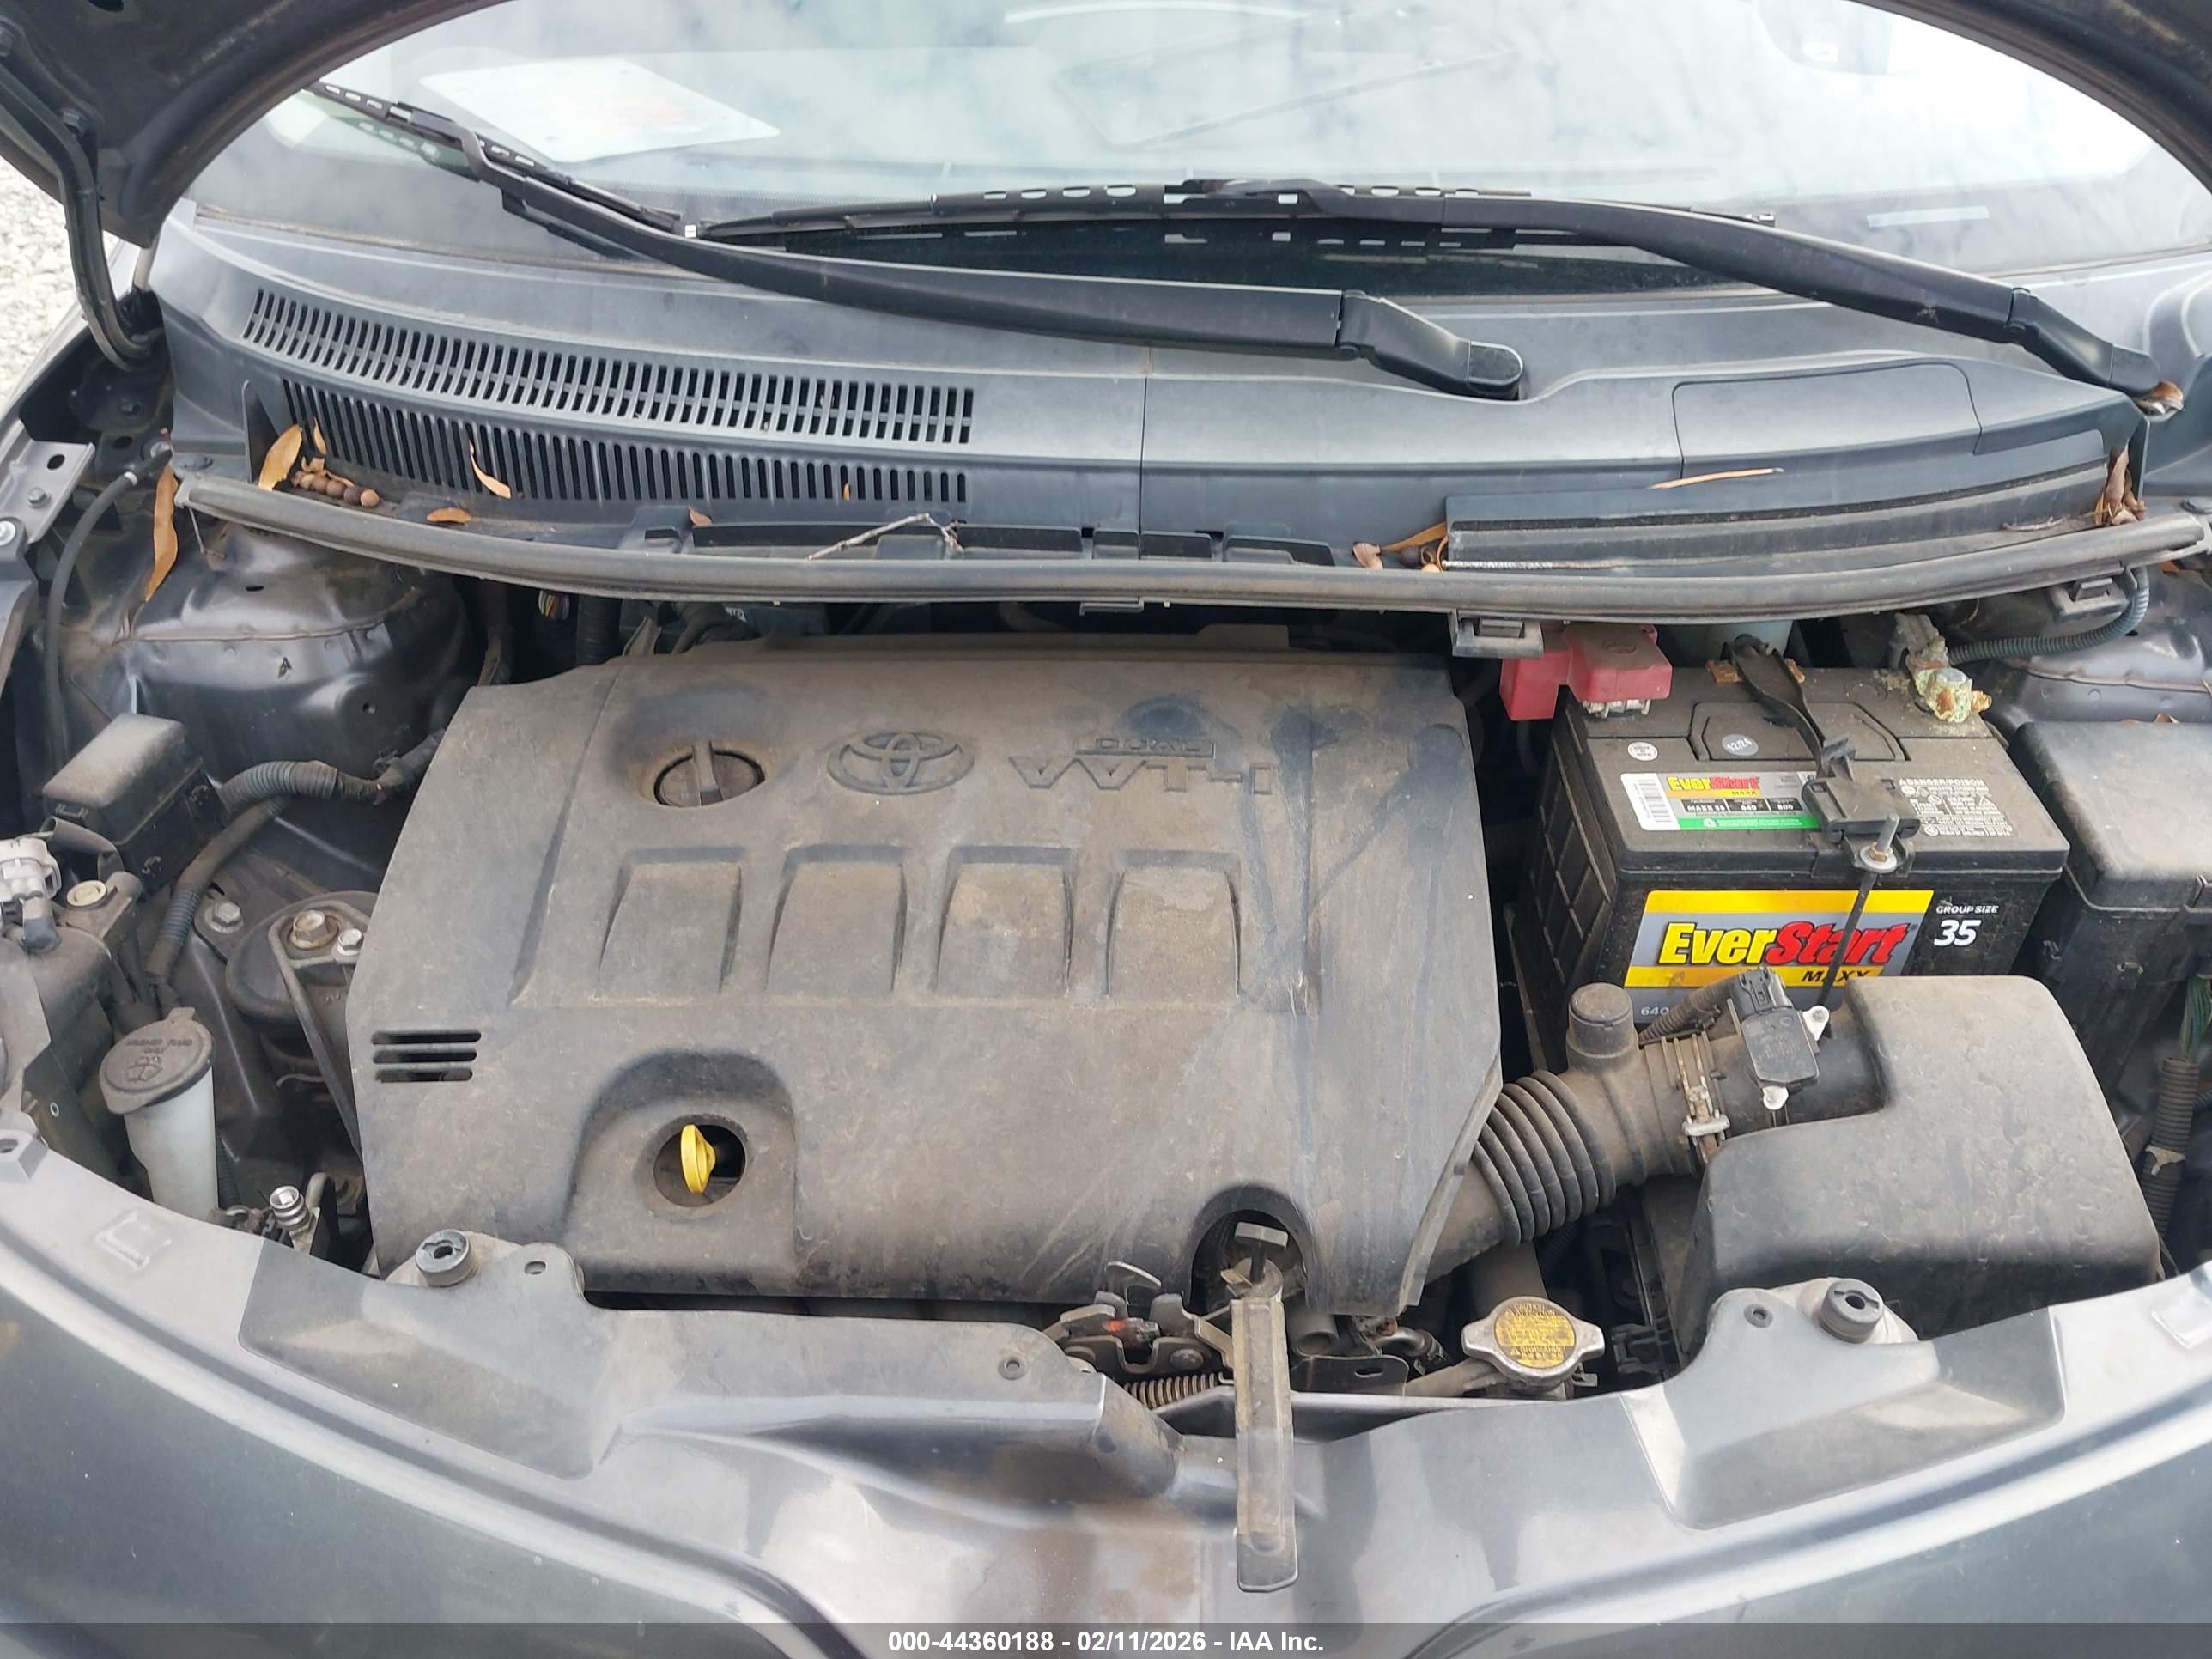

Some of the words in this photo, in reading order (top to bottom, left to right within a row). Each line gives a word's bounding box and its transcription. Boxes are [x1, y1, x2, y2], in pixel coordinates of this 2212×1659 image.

[1095, 738, 1200, 752] DUAL
[1668, 775, 1760, 791] EverStart
[1936, 905, 1974, 915] GROUP
[1974, 905, 1999, 914] SIZE
[1934, 919, 1982, 946] 35
[1657, 921, 1909, 965] EverStart
[1640, 1006, 1670, 1016] 640
